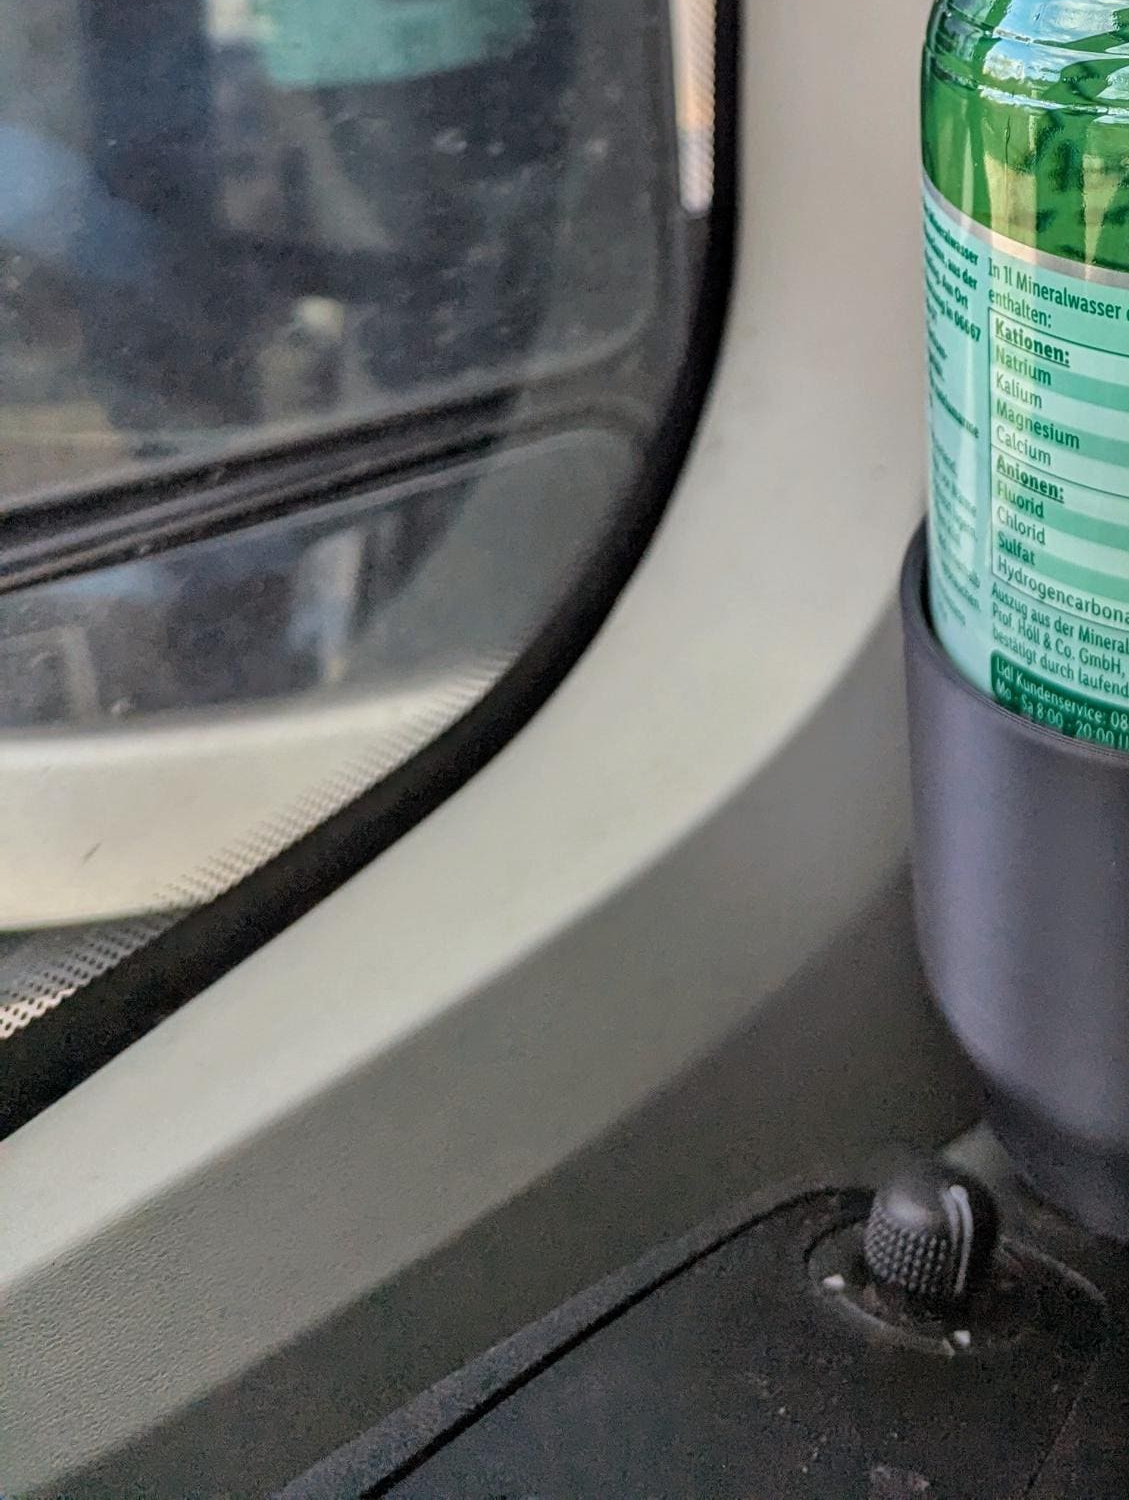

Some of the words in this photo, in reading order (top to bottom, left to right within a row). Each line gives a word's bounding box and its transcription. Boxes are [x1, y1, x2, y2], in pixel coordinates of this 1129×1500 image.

[987, 256, 1000, 280] In
[1016, 271, 1121, 319] Mineralwasser
[988, 288, 1052, 328] enthalten:
[995, 316, 1070, 365] Kationen:
[995, 345, 1051, 386] Natrium
[995, 371, 1042, 409] Kalium
[996, 399, 1080, 449] Magnesium
[996, 424, 1051, 466] Calcium
[996, 453, 1065, 501] Anionen:
[996, 481, 1044, 519] Fluorid
[996, 505, 1045, 545] Chlorid
[997, 530, 1036, 566] Sulfat
[991, 581, 1028, 621] Auszug
[1031, 608, 1050, 628] aus
[1054, 615, 1075, 638] der
[992, 622, 1037, 665] bestätigt
[1040, 653, 1075, 681] durch
[1018, 618, 1040, 645] Höll
[1043, 632, 1052, 651] &
[1055, 637, 1076, 661] Co.
[1079, 646, 1126, 678] GmbH,
[1016, 670, 1106, 724] Kundenservice:
